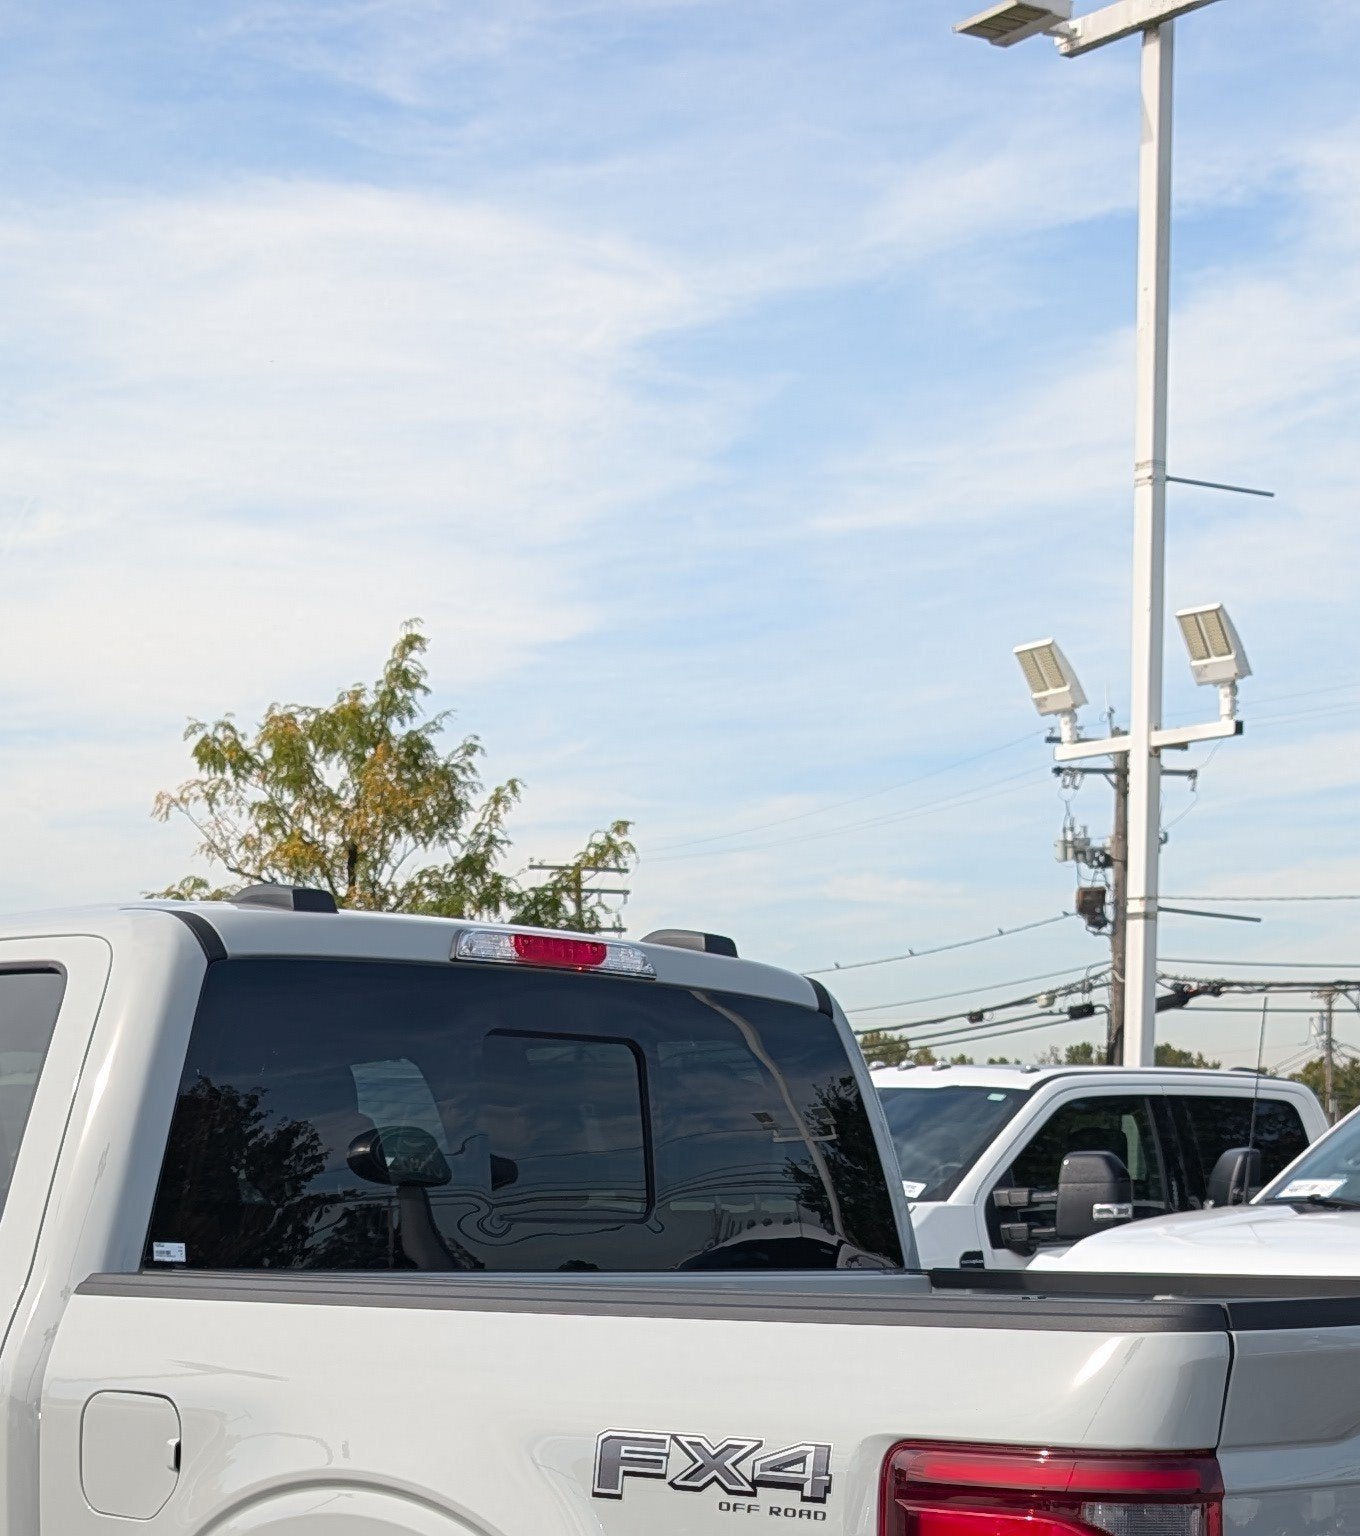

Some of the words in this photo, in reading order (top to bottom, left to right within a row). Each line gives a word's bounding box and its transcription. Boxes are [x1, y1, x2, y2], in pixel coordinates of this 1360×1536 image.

[592, 1428, 833, 1504] FX4
[718, 1501, 760, 1515] OFF
[769, 1504, 827, 1521] ROAD
